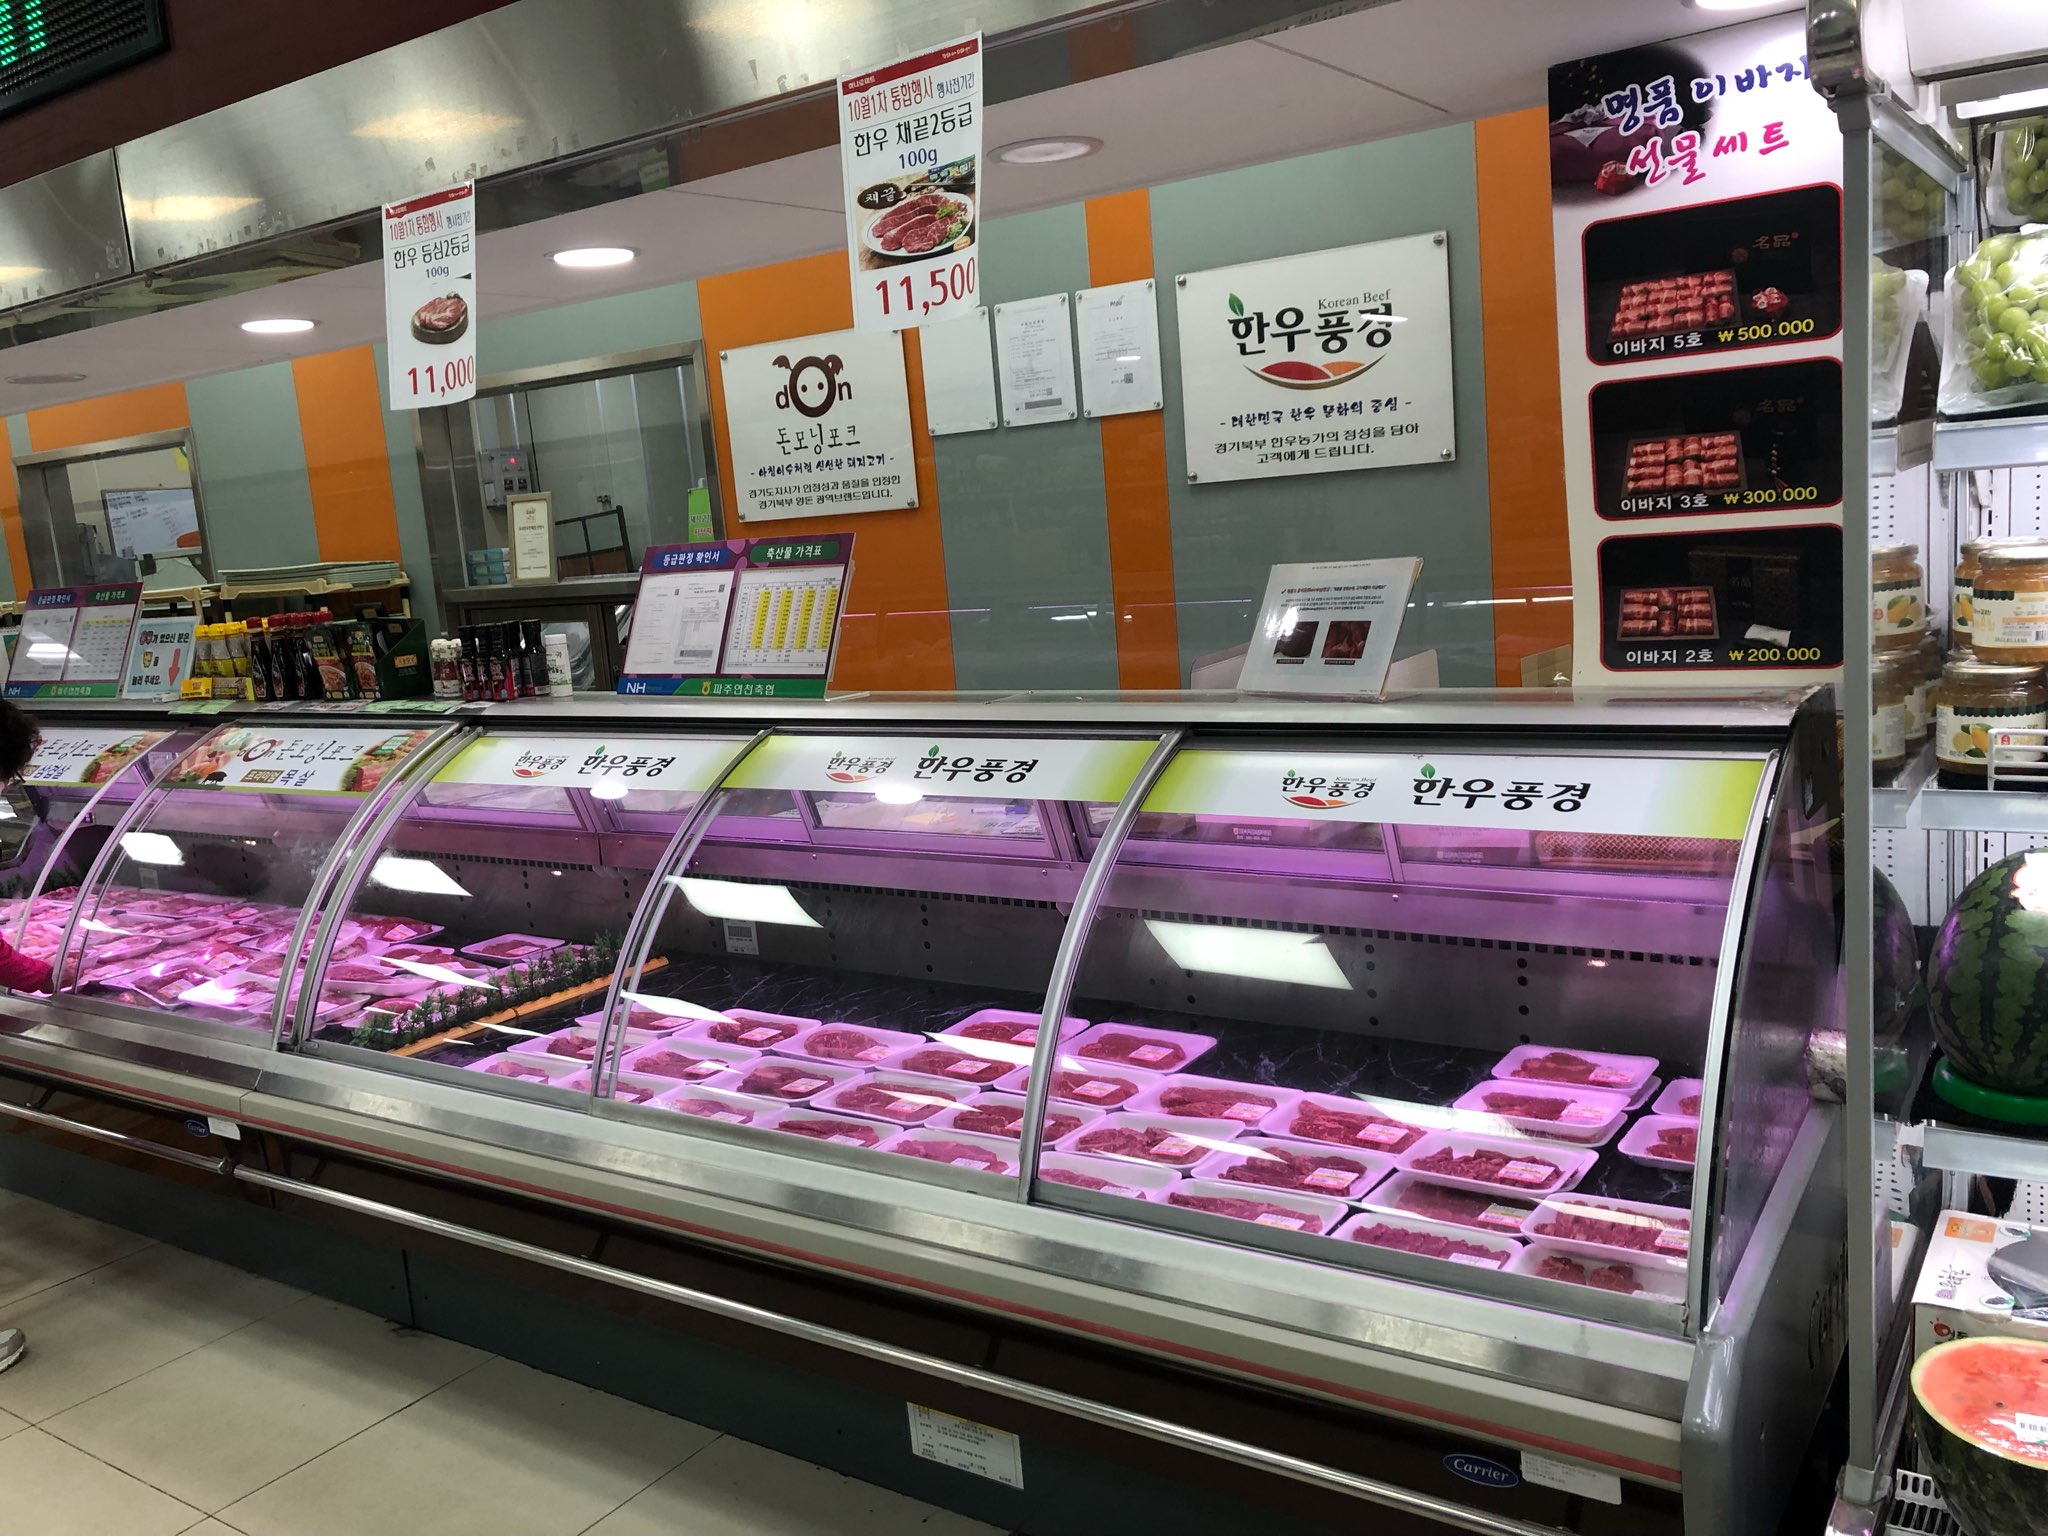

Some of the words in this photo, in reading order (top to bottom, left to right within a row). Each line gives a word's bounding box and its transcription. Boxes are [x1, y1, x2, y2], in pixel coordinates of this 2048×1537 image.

[891, 75, 934, 111] 통합행사
[937, 72, 975, 99] 행사전기간
[1604, 76, 1682, 134] 명품
[854, 127, 889, 157] 한우
[895, 102, 972, 145] 채끝2등급
[898, 148, 938, 169] 100g
[416, 210, 443, 236] 통합행사
[394, 247, 418, 270] 한우
[421, 233, 470, 264] 등심2등급
[425, 266, 450, 279] 100g
[875, 256, 975, 316] 11,500
[1317, 295, 1360, 311] Korean
[1362, 289, 1392, 304] Beef
[1227, 302, 1395, 356] 한우풍경
[1612, 335, 1666, 357] 이바지
[1673, 331, 1704, 350] 5호
[407, 355, 475, 398] 11,000
[1290, 406, 1317, 423] 한우
[775, 422, 861, 456] 돈모닝포크
[1214, 439, 1268, 455] 경기북부
[1270, 431, 1341, 449] 한우농가의
[1343, 426, 1387, 442] 정성을
[1390, 422, 1420, 438] 담아
[1256, 449, 1311, 465] 고객에게
[1314, 443, 1376, 460] 드립니다.
[748, 485, 801, 499] 경기도지사가
[758, 496, 794, 510] 경기북부
[1620, 495, 1672, 513] 이바지
[1679, 493, 1710, 510] 3호
[662, 551, 694, 567] 등급판정
[695, 549, 721, 563] 확인서
[766, 546, 792, 560] 축산물
[795, 545, 822, 558] 가격표
[1626, 649, 1678, 665] 이바지
[1684, 648, 1715, 664] 2호
[8, 687, 21, 696] NH
[626, 682, 647, 695] NH
[712, 683, 775, 696] 파주연천축협
[276, 739, 364, 765] 돈모닝포크
[514, 755, 567, 770] 한우풍경
[33, 764, 72, 780] 삼겹살
[577, 754, 677, 777] 한우풍경
[826, 756, 894, 774] 한우풍경
[913, 756, 1040, 784] 한우풍경
[281, 769, 317, 787] 목살
[1281, 776, 1376, 799] 한우풍경
[1412, 776, 1592, 813] 한우풍경
[1454, 1459, 1509, 1481] Carrier
